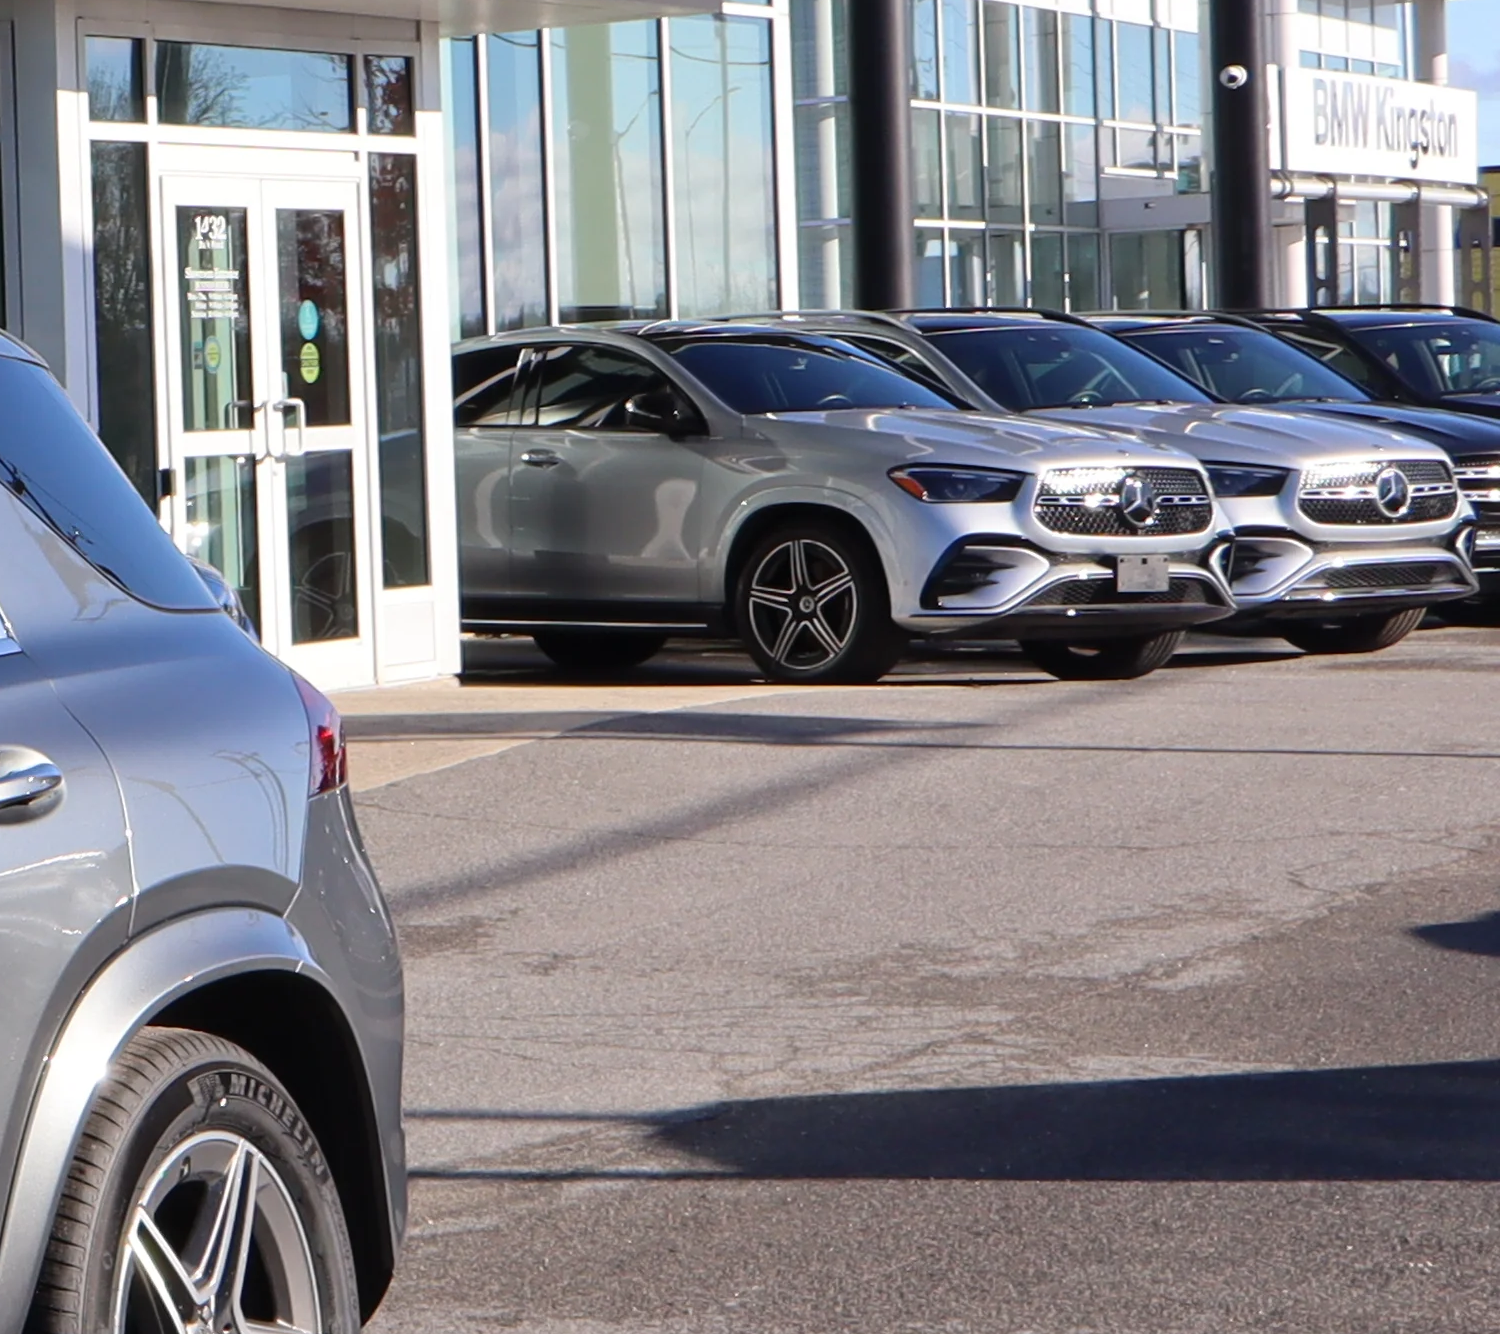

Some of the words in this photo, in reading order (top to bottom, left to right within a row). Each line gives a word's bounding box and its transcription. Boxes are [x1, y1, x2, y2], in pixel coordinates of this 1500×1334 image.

[1313, 78, 1370, 149] BMW
[1375, 86, 1458, 170] Kingston
[229, 1073, 325, 1175] MICHELIN
